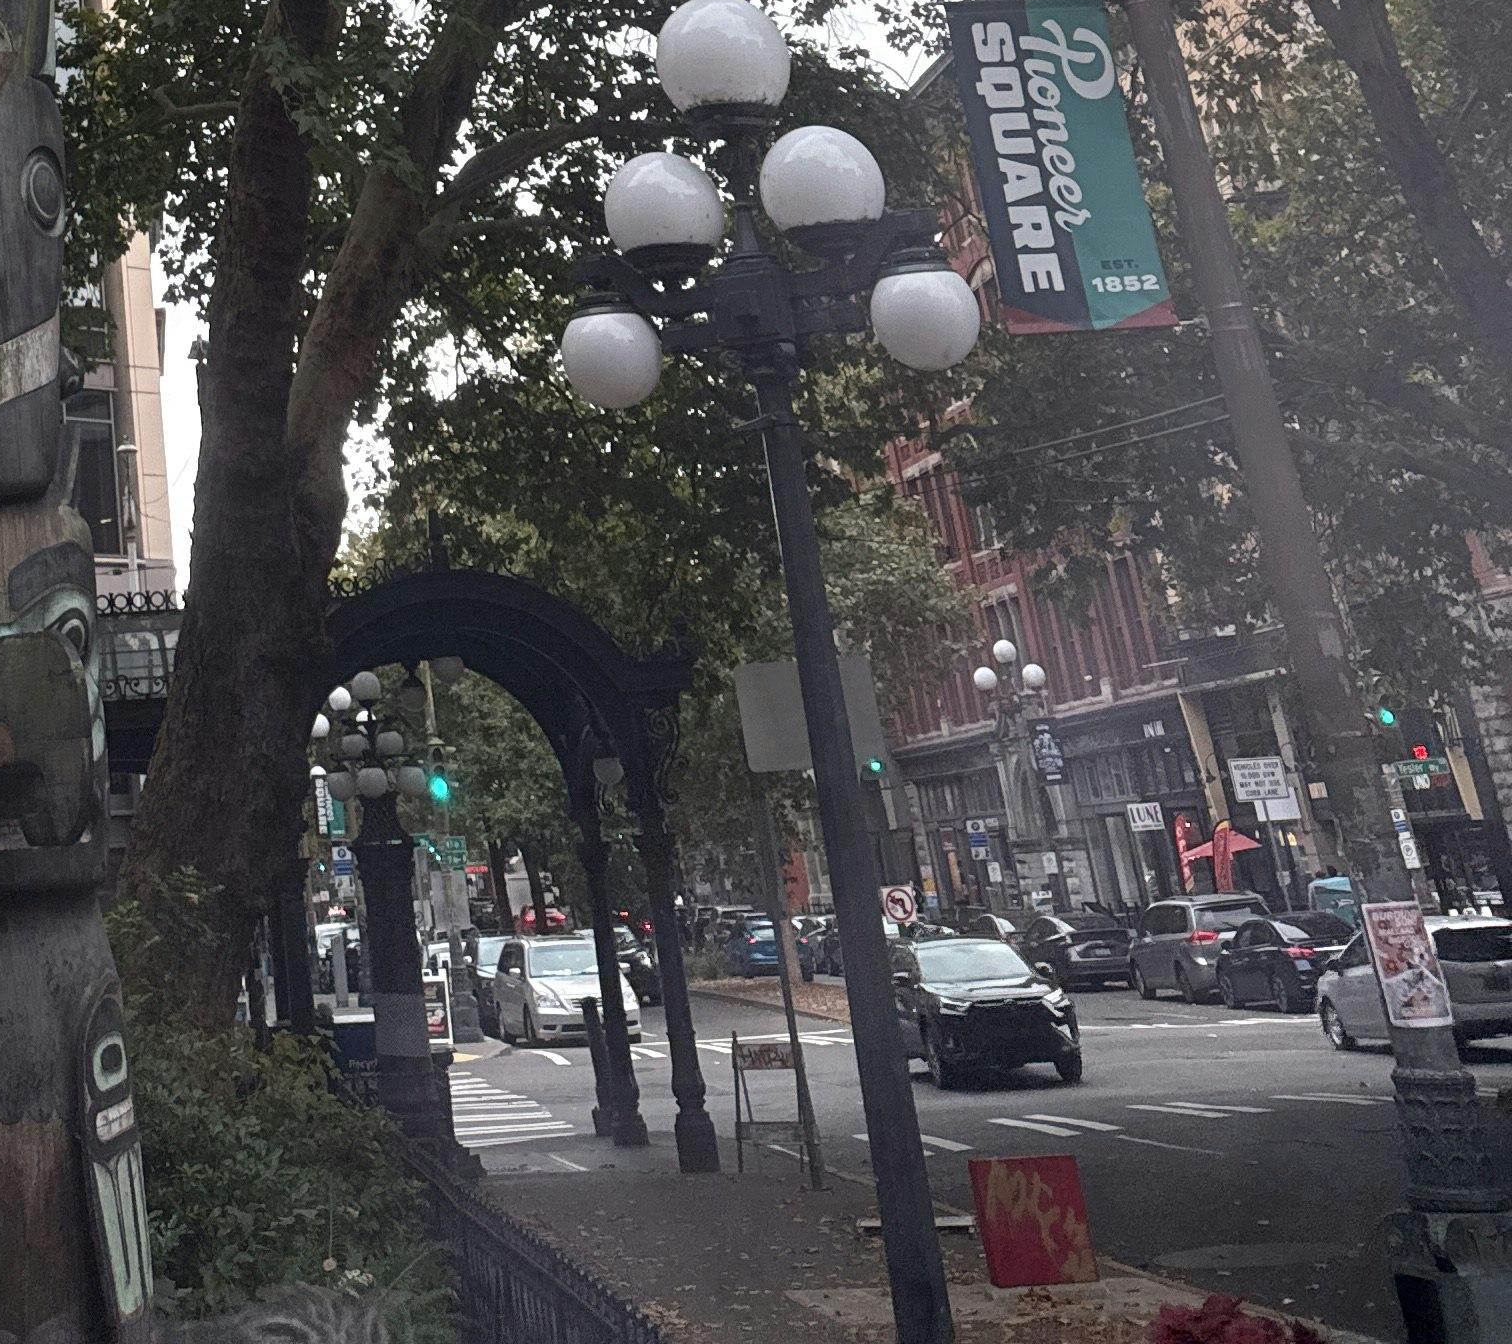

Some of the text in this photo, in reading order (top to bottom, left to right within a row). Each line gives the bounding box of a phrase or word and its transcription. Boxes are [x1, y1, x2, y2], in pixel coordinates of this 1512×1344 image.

[1019, 18, 1115, 233] Pioneer
[971, 21, 1066, 293] SQUARE
[1100, 259, 1140, 271] EST.
[1092, 274, 1160, 292] 1852
[1233, 761, 1279, 771] VEHICLES OVER
[1254, 780, 1266, 788] NOT
[1129, 805, 1163, 824] LUNE
